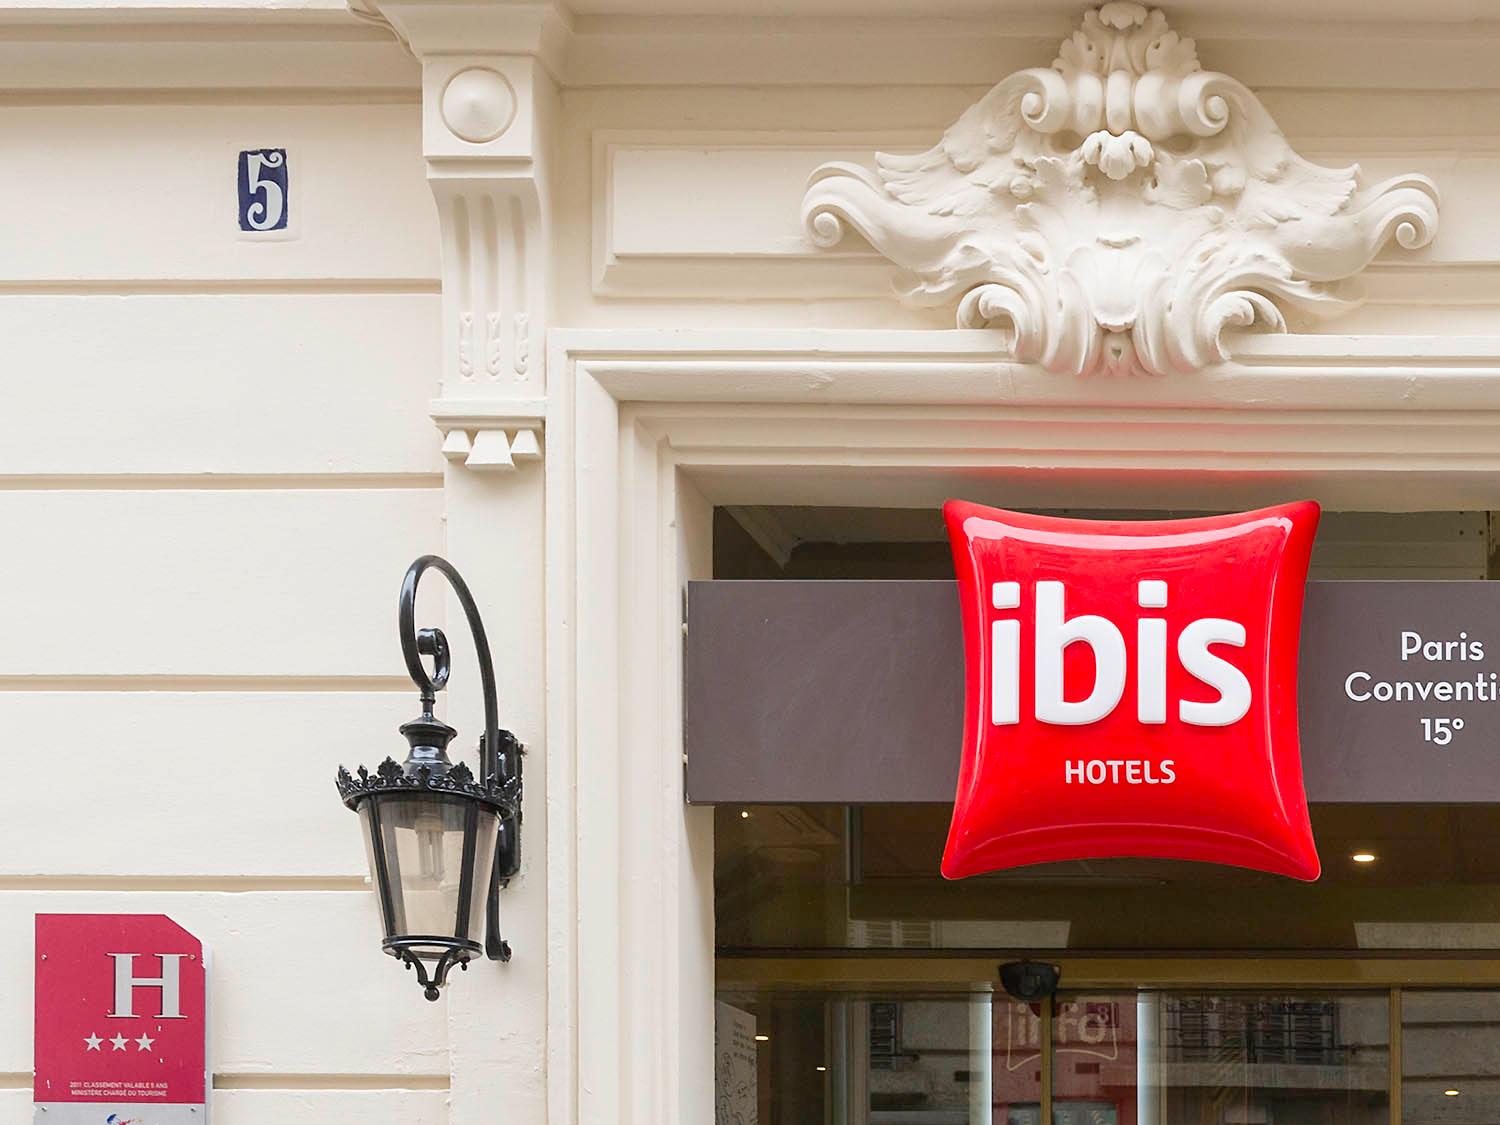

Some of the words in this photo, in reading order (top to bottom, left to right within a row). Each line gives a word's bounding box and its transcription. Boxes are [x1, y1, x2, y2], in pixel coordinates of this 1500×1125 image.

[247, 151, 283, 230] 5
[991, 580, 1252, 728] ibis
[1401, 631, 1485, 661] Paris
[1064, 759, 1177, 785] HOTELS
[105, 952, 189, 1019] H
[83, 1081, 123, 1089] CLASSEMENT
[123, 1081, 149, 1089] VALABLE
[155, 1081, 169, 1089] ANS
[138, 1089, 168, 1097] TOURISME
